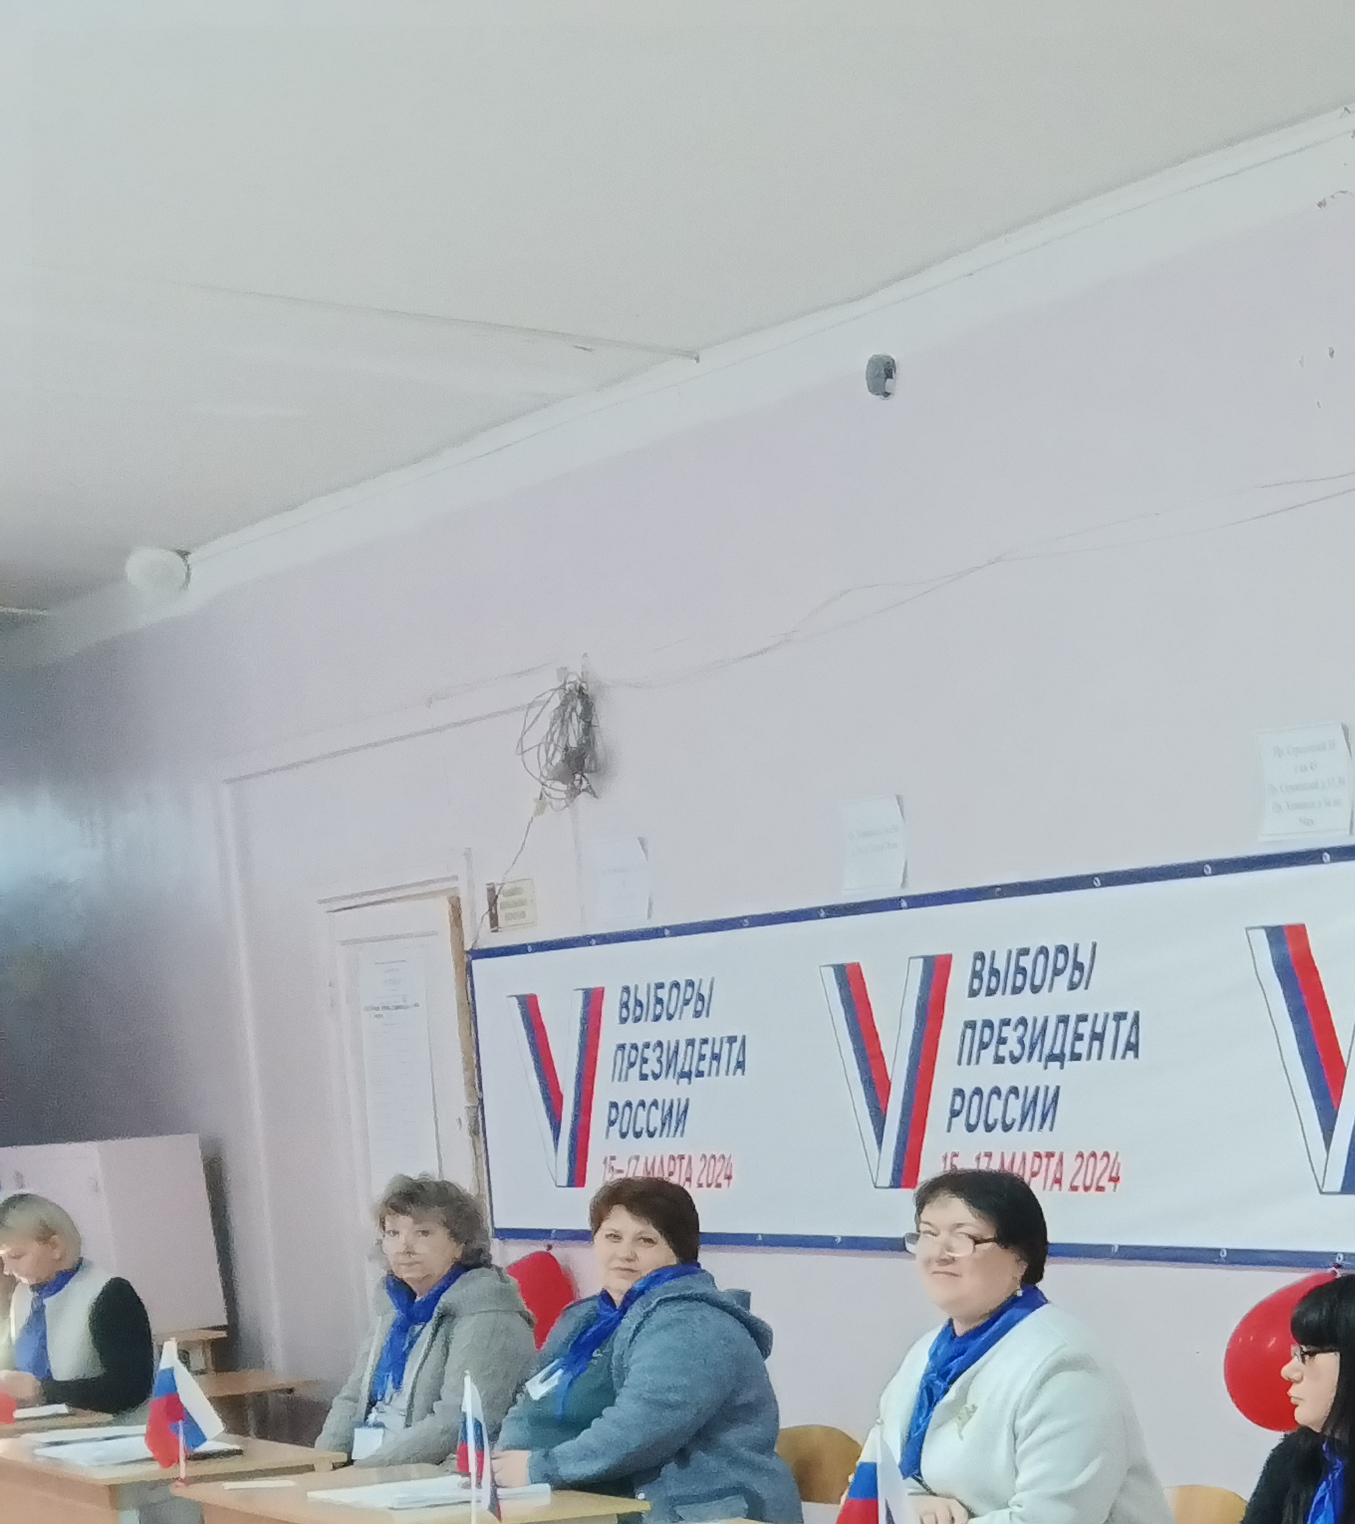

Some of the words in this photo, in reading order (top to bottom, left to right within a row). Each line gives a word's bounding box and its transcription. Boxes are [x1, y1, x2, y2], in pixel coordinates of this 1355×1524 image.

[967, 941, 1097, 999] ВЫБОРЫ
[618, 977, 715, 1025] ВЫБОРЫ
[611, 1034, 746, 1085] ПРЕЗИДЕНТА
[957, 1010, 1140, 1070] ПРЕЗИДЕНТА
[605, 1097, 689, 1140] РОССИИ
[946, 1085, 1060, 1133] РОССИИ
[643, 1154, 692, 1189] МАРТА
[697, 1153, 732, 1189] 2024
[1068, 1150, 1121, 1193] 2024
